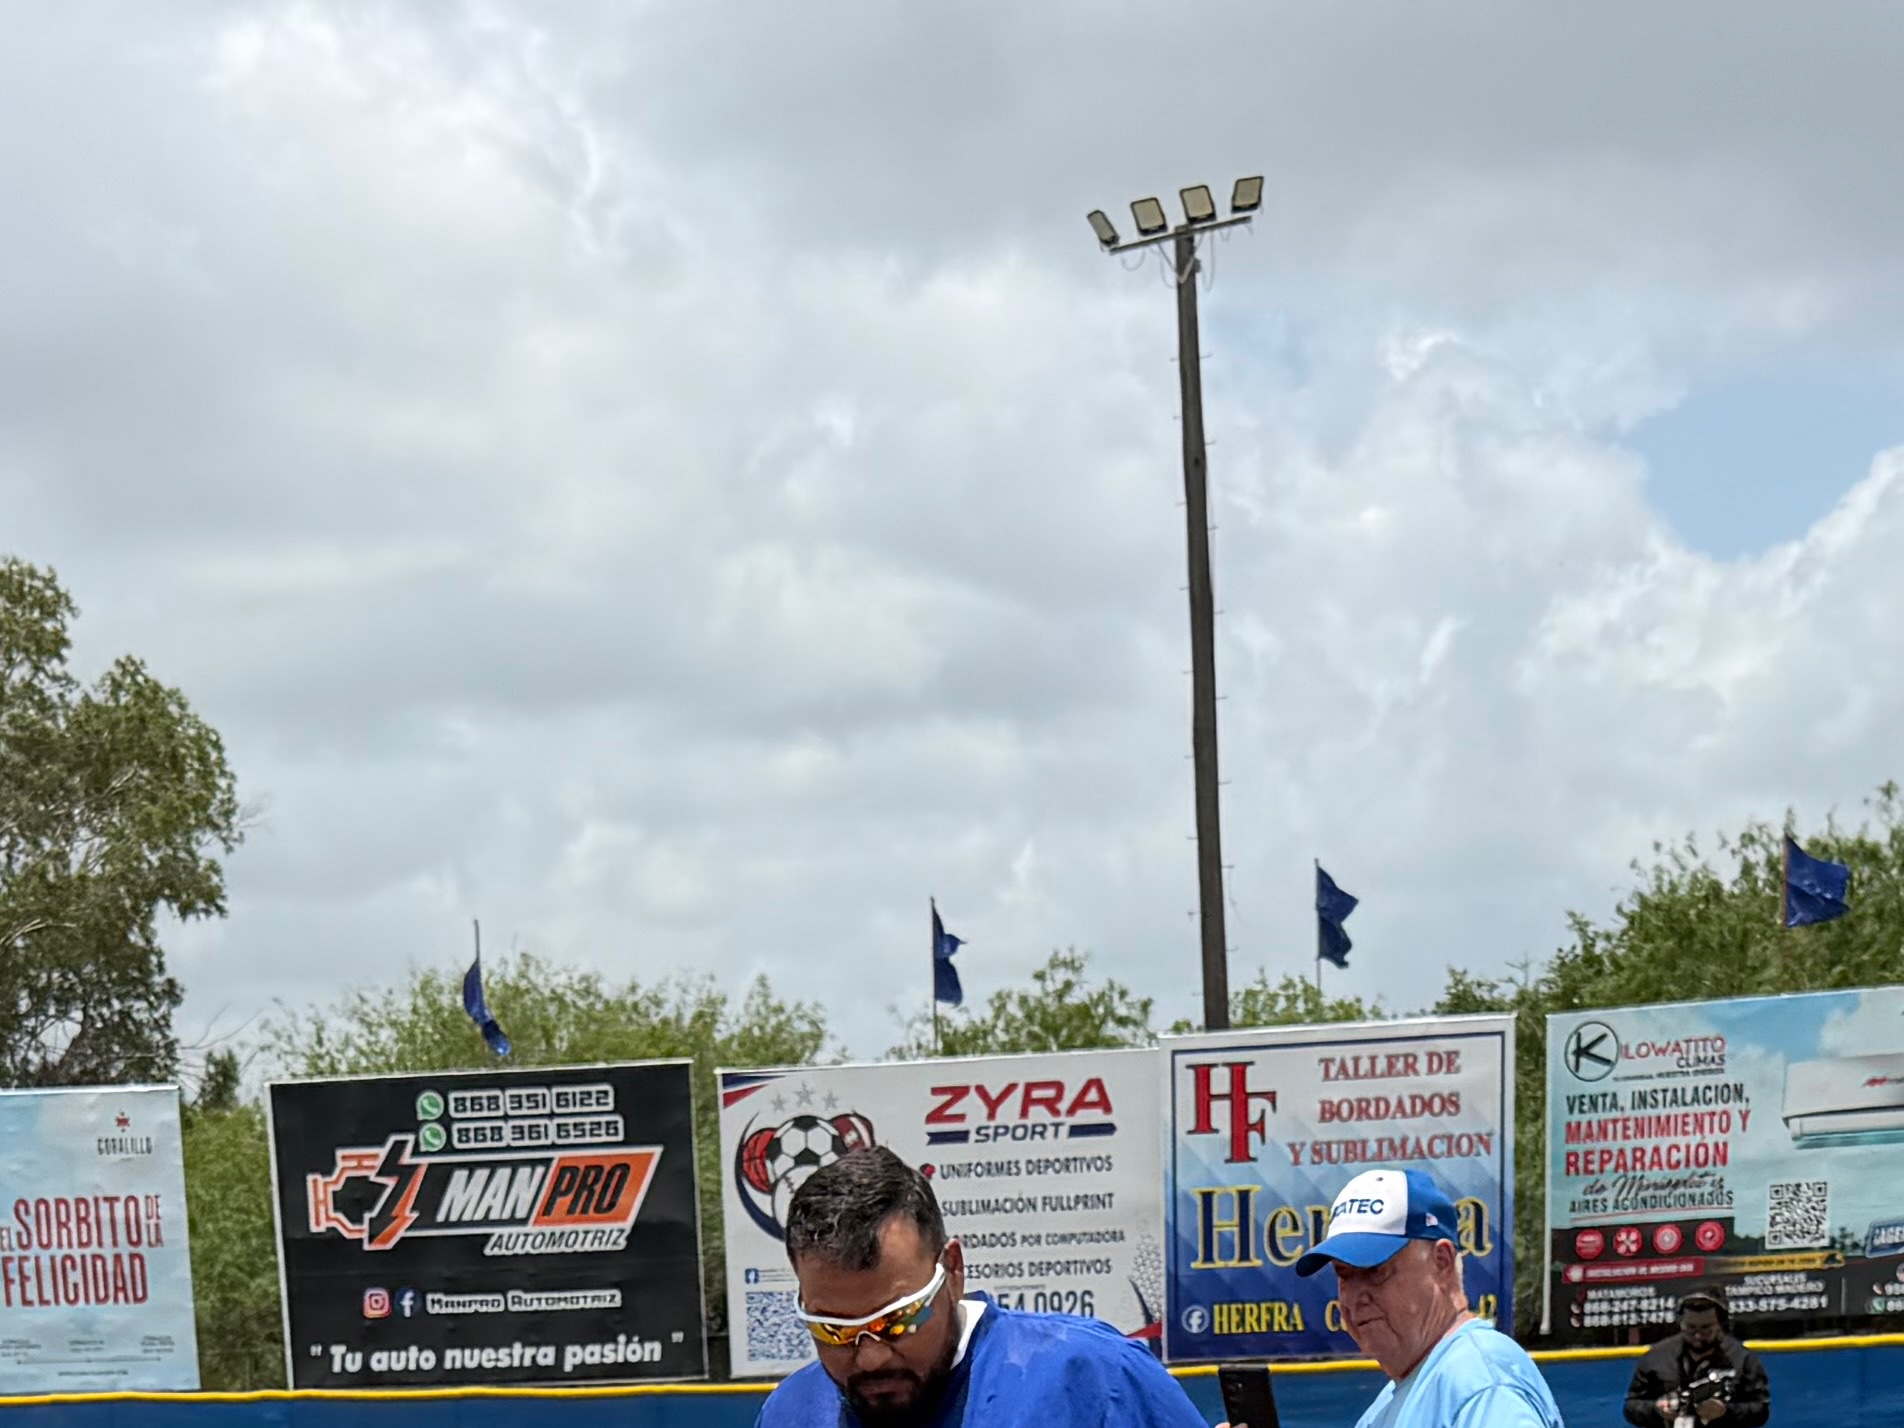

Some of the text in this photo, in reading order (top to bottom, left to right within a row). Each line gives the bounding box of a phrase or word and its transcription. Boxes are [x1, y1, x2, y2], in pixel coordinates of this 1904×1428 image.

[1318, 1051, 1461, 1082] TALLER DE
[1676, 1054, 1725, 1069] CLIMAS
[452, 1088, 611, 1114] 868 351 6122
[924, 1077, 1114, 1125] ZYRA
[1318, 1093, 1461, 1123] BORDADOS
[455, 1124, 504, 1145] 868
[508, 1122, 550, 1143] 361
[974, 1121, 1066, 1144] SPORT
[1564, 1109, 1751, 1144] MANTENIMIENTO Y
[1288, 1132, 1494, 1166] Y SUBLIMACION
[1564, 1137, 1728, 1176] REPARACIÓN
[940, 1155, 1113, 1180] UNIFORMES DEPORTIVOS
[1042, 1193, 1114, 1212] FULLPRINT
[1569, 1190, 1734, 1213] AIRES ACONDICIONADOS
[0, 1195, 162, 1252] EL SORBITO DE
[147, 1222, 164, 1248] LA
[487, 1229, 627, 1254] AUTOMOTRIZ
[1020, 1234, 1042, 1246] POR
[1045, 1230, 1126, 1246] COMPUTADORA
[1, 1253, 150, 1308] FELICIDAD
[963, 1259, 1112, 1279] CESORIOS DEPORTIVOS
[1034, 1290, 1095, 1318] 0926
[1213, 1302, 1304, 1335] HERFRA
[330, 1333, 661, 1373] Tu auto nuestra pasión
